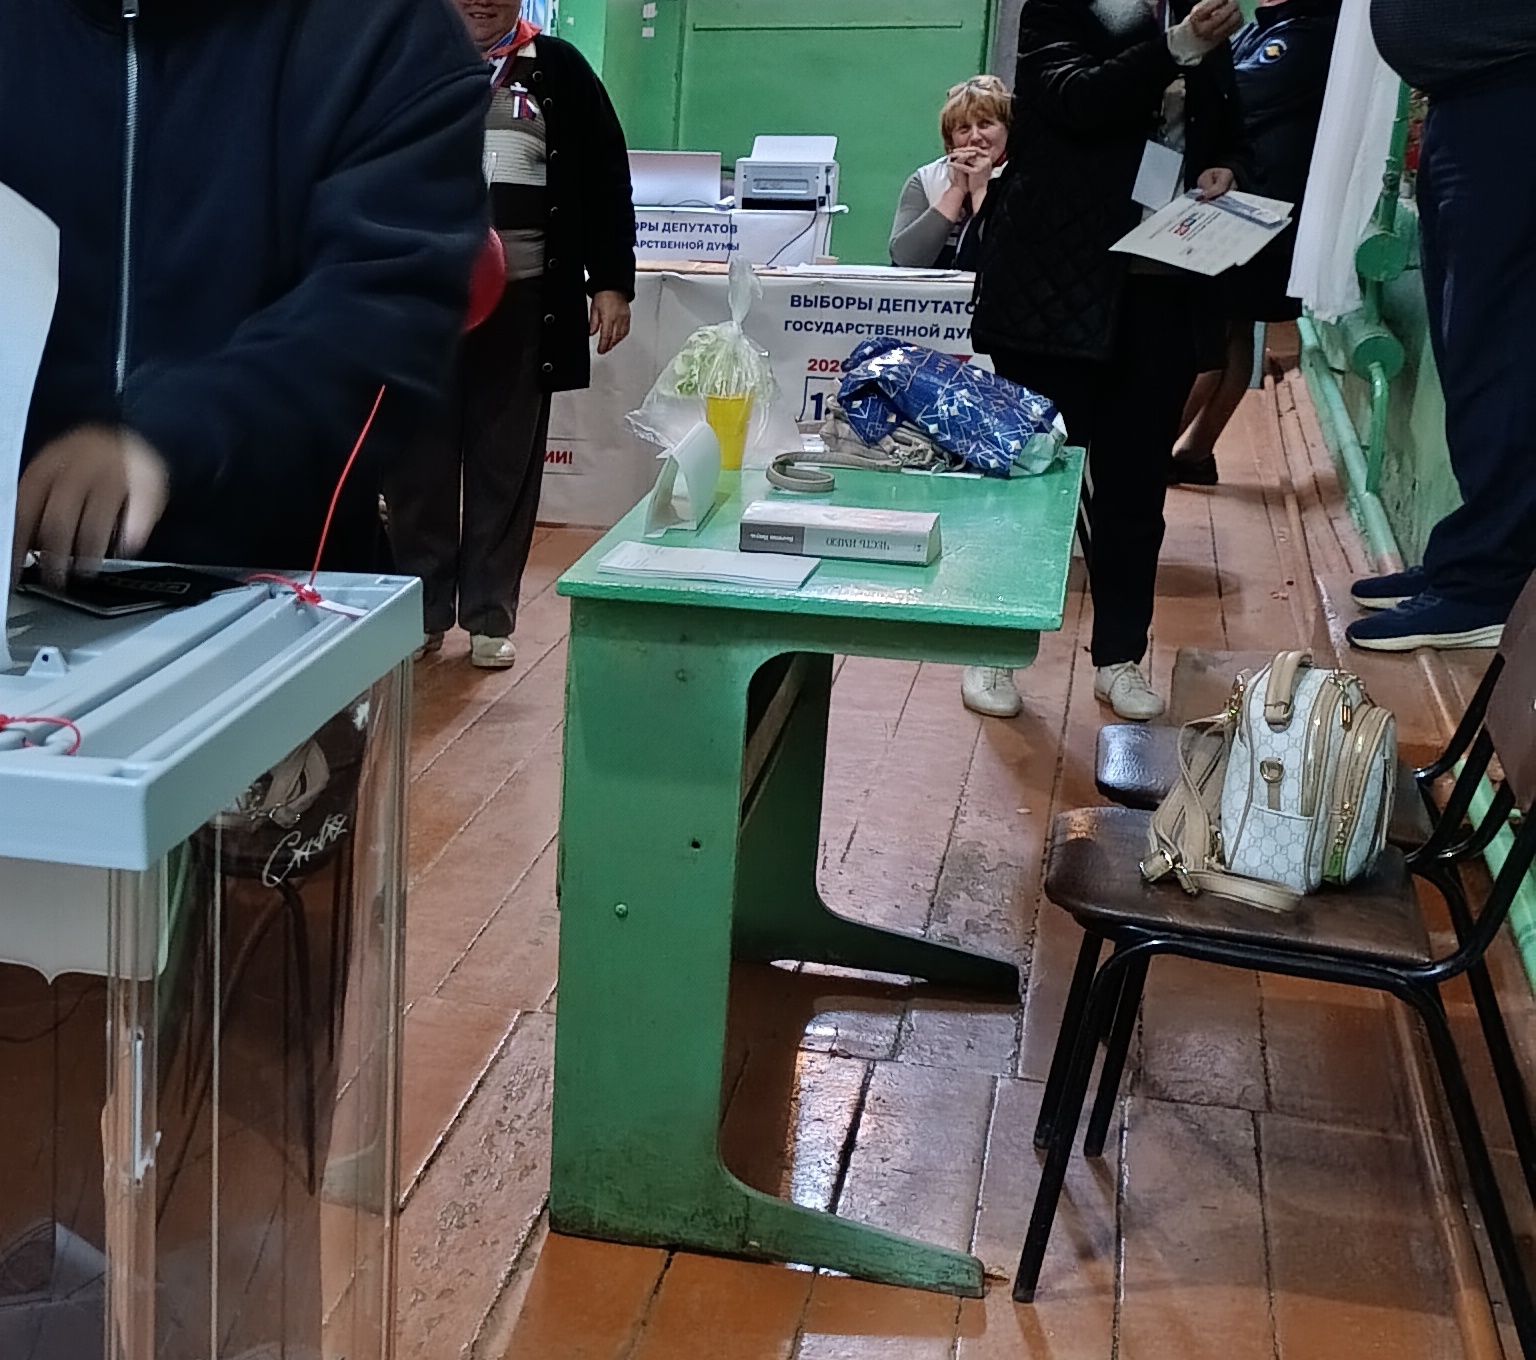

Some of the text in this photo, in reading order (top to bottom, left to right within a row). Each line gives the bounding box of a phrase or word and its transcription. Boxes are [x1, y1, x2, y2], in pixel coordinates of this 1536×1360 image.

[662, 222, 738, 234] ДЕПУТАТОВ
[706, 241, 740, 252] ДУМЫ
[790, 294, 873, 311] ВЫБОРЫ
[784, 319, 940, 339] ГОСУДАРСТВЕННОЙ
[807, 358, 841, 373] 202
[825, 537, 890, 551] ЧЕСТЬ ИМЕЮ
